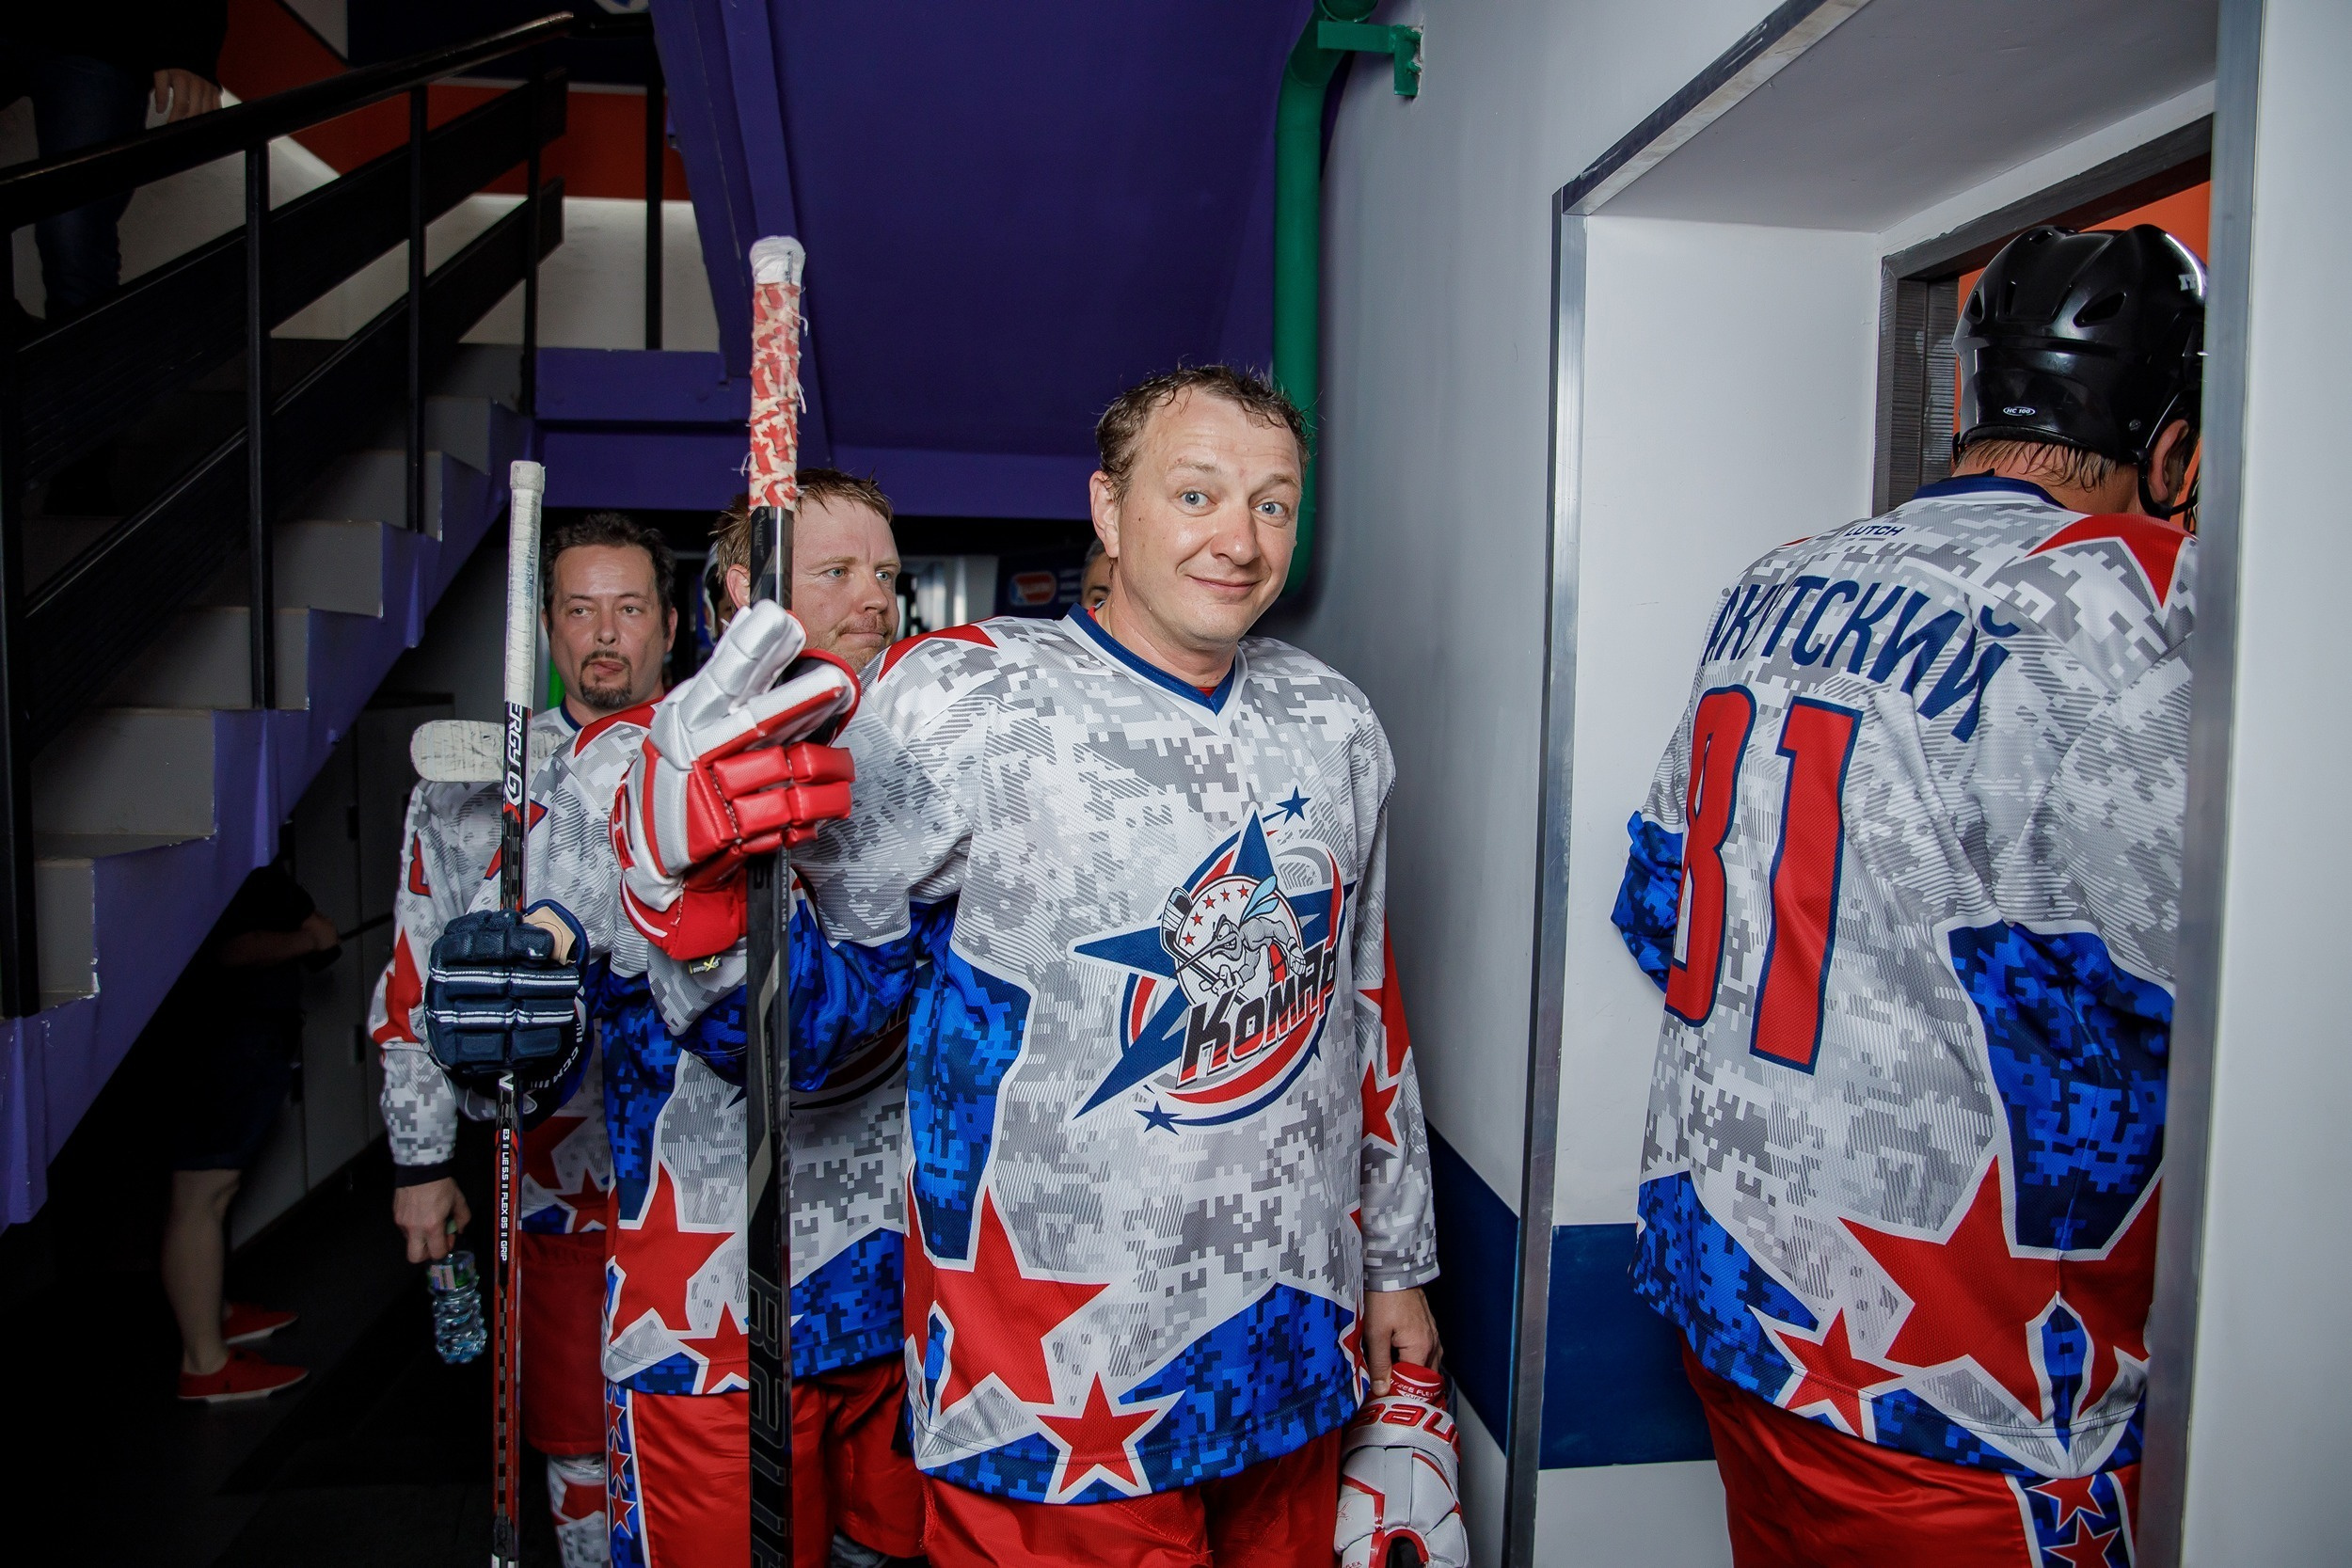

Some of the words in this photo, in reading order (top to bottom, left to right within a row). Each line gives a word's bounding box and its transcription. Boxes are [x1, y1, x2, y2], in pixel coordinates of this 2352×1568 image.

[1844, 525, 1906, 537] LUTCH
[1664, 683, 1864, 1075] 81
[552, 1046, 580, 1084] CCM
[779, 1058, 790, 1215] NEXUS
[501, 1192, 509, 1215] FLEX
[500, 1240, 508, 1261] GRIP
